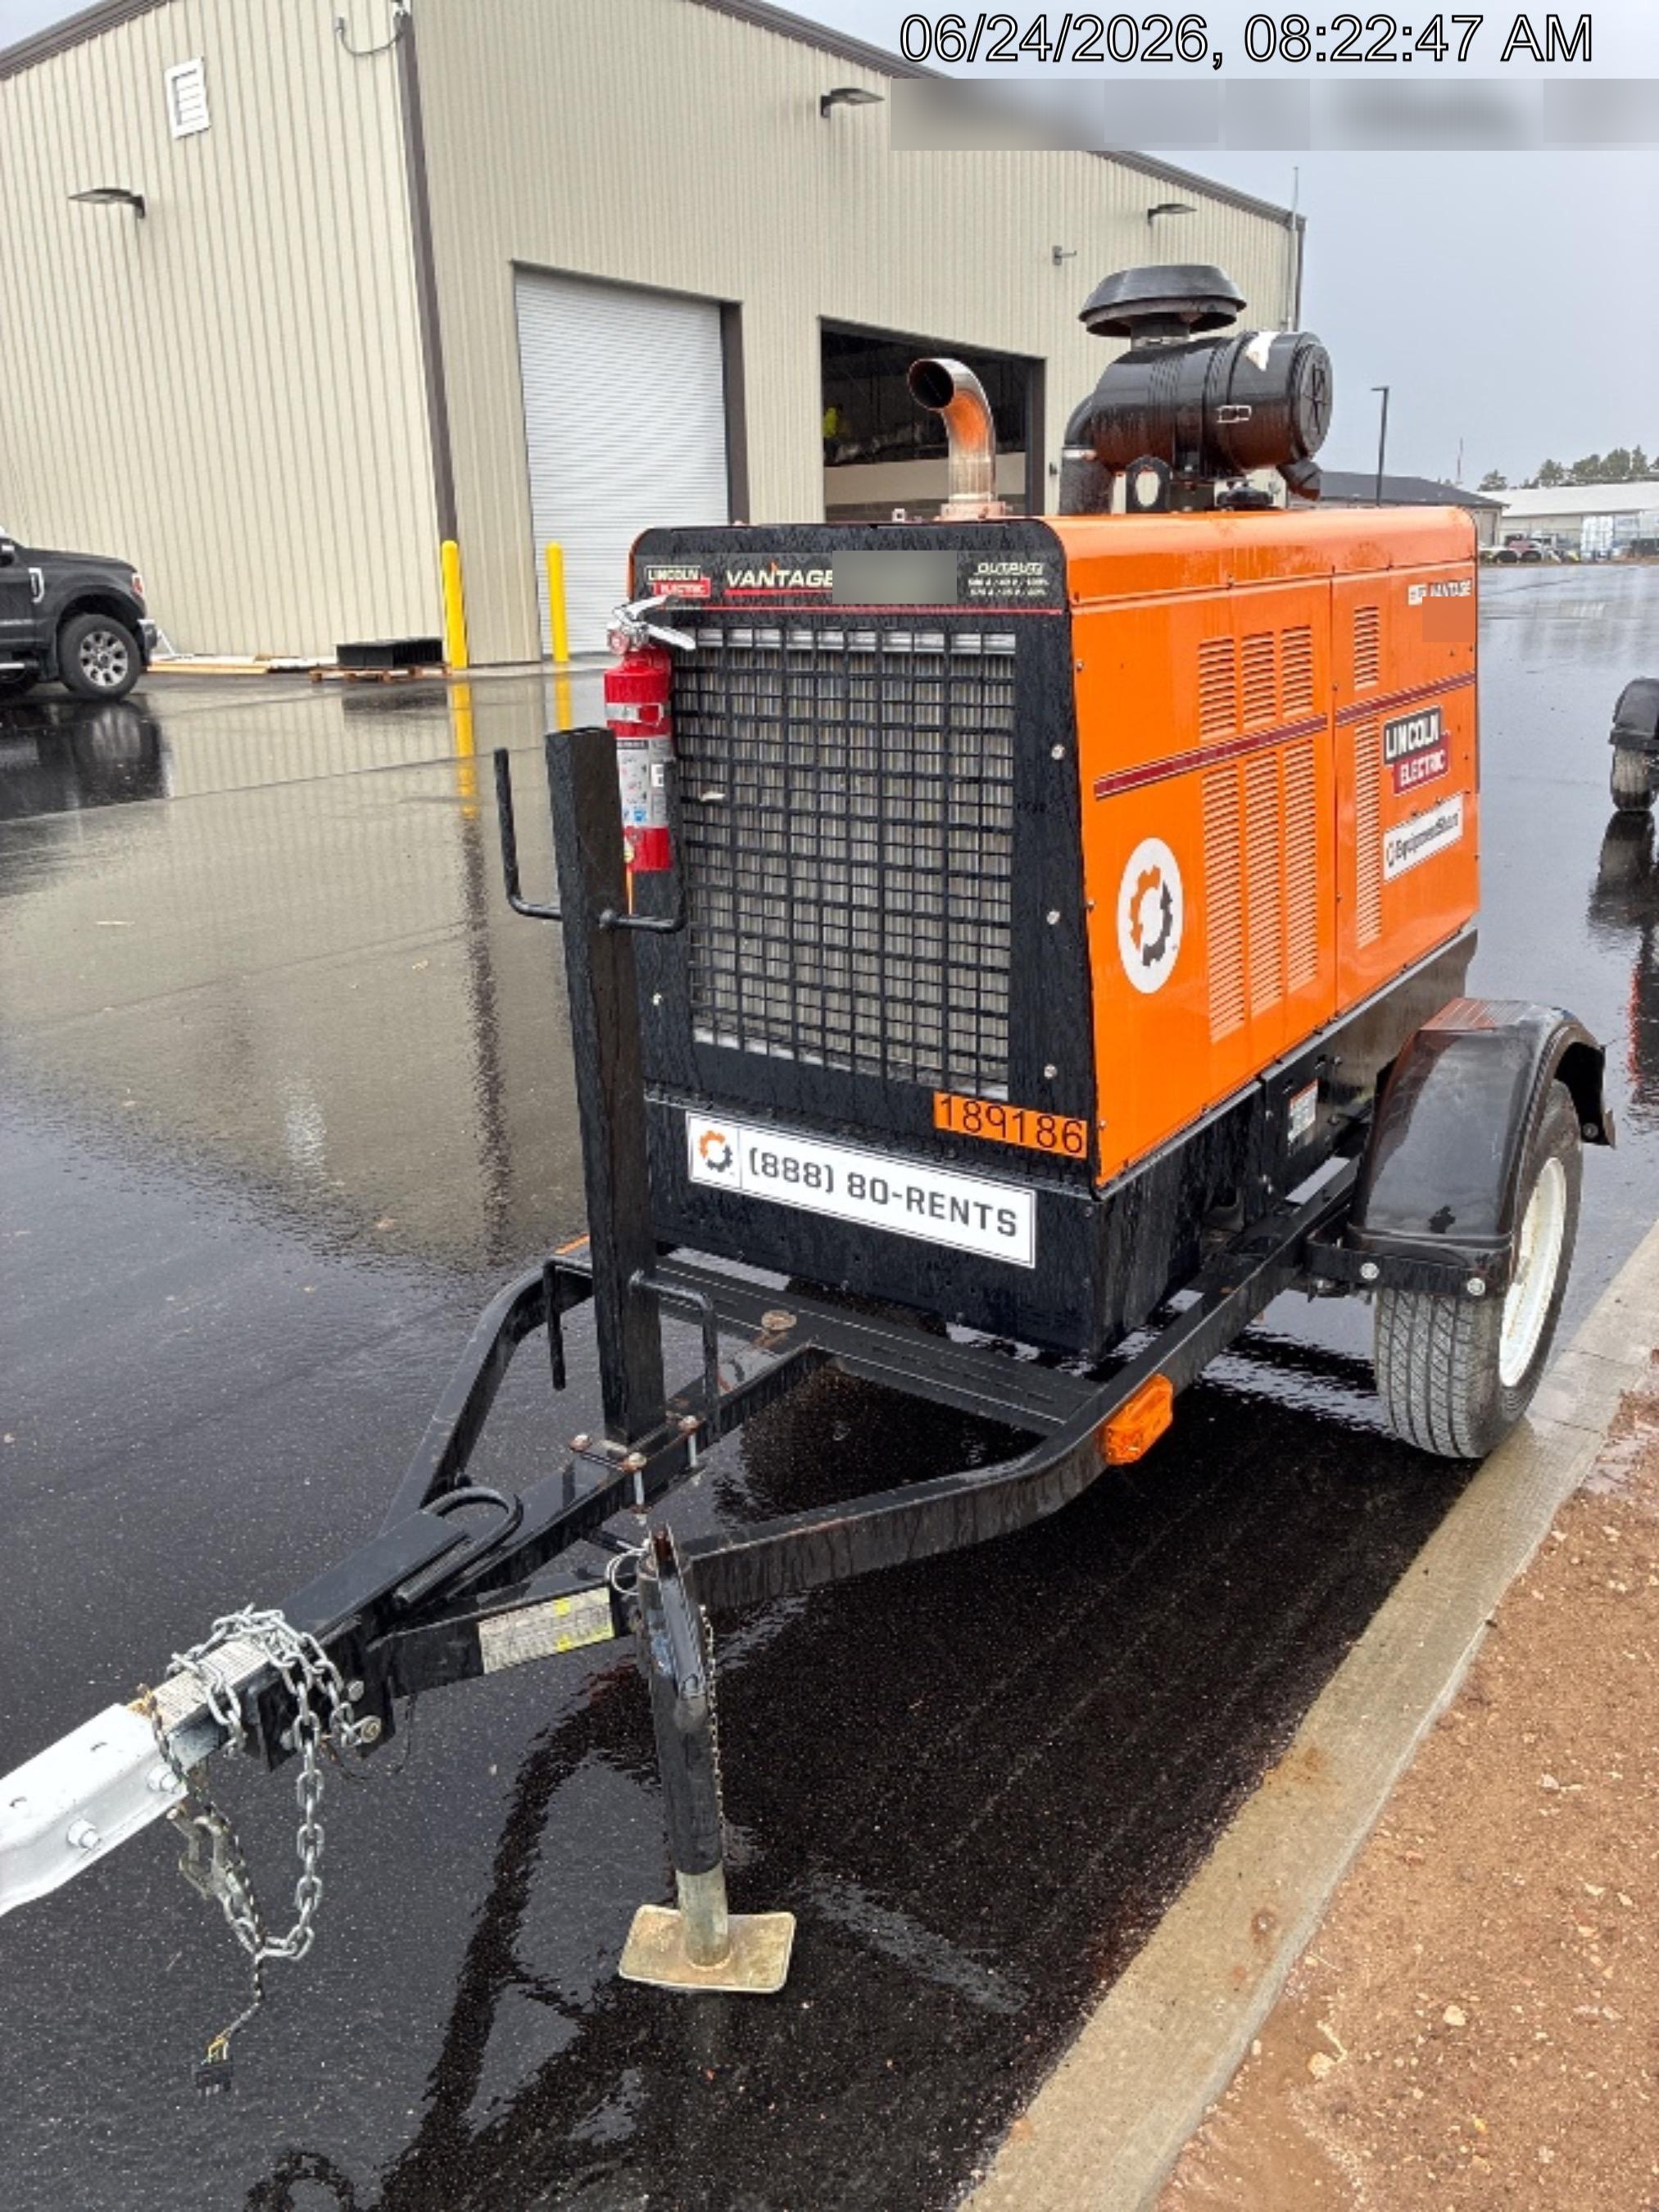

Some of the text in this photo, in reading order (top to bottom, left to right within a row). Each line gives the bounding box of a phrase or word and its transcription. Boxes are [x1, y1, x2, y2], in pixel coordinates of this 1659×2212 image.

[648, 568, 700, 581] LINCOLN
[1385, 711, 1439, 760] LINCOLN
[1399, 749, 1446, 787] ELECTRIC
[940, 1095, 1083, 1154] 189186
[749, 1145, 1017, 1237] (888) 80-RENTS
